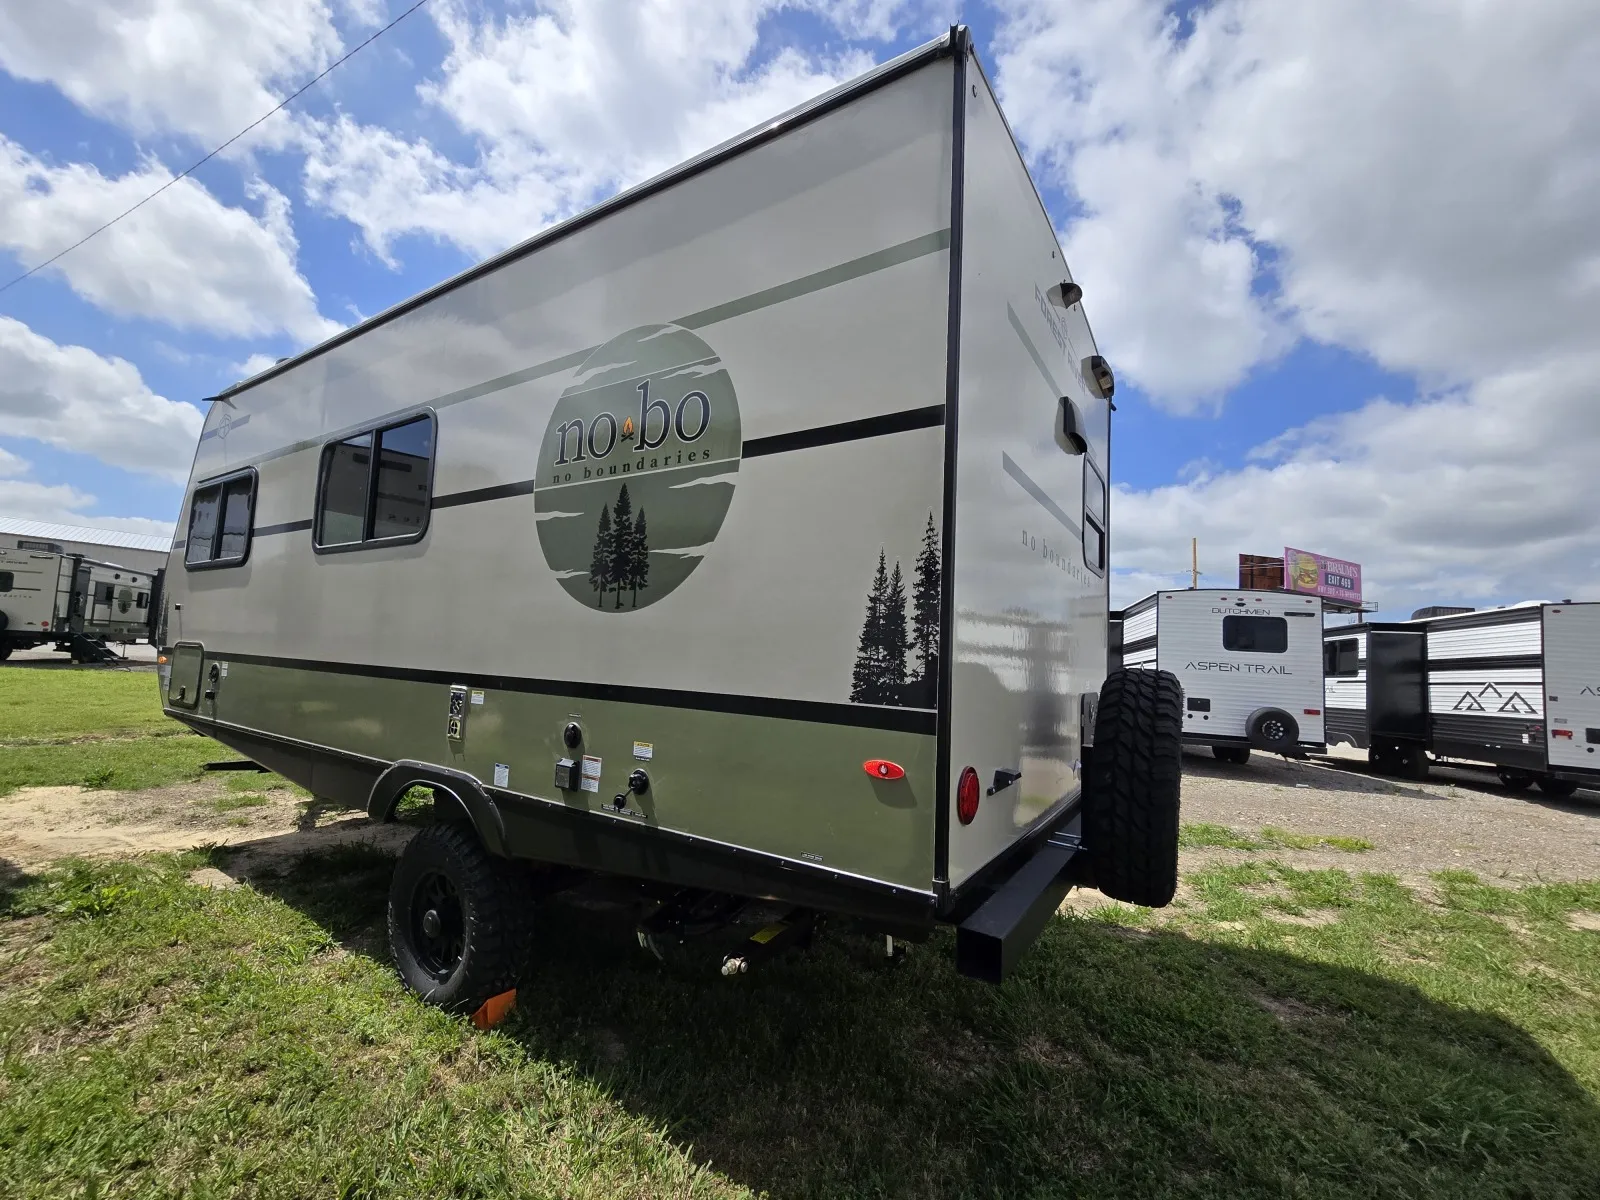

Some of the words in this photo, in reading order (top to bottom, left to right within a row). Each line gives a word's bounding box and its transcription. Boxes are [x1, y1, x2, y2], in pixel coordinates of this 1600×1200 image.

[553, 472, 571, 484] no
[584, 448, 710, 480] boundaries
[1022, 530, 1035, 551] no
[1043, 538, 1090, 588] boundaries
[1328, 575, 1340, 585] EXIT
[1211, 607, 1271, 615] DUTCHMEN
[1185, 661, 1239, 672] ASPEN
[1244, 663, 1292, 675] TRAIL
